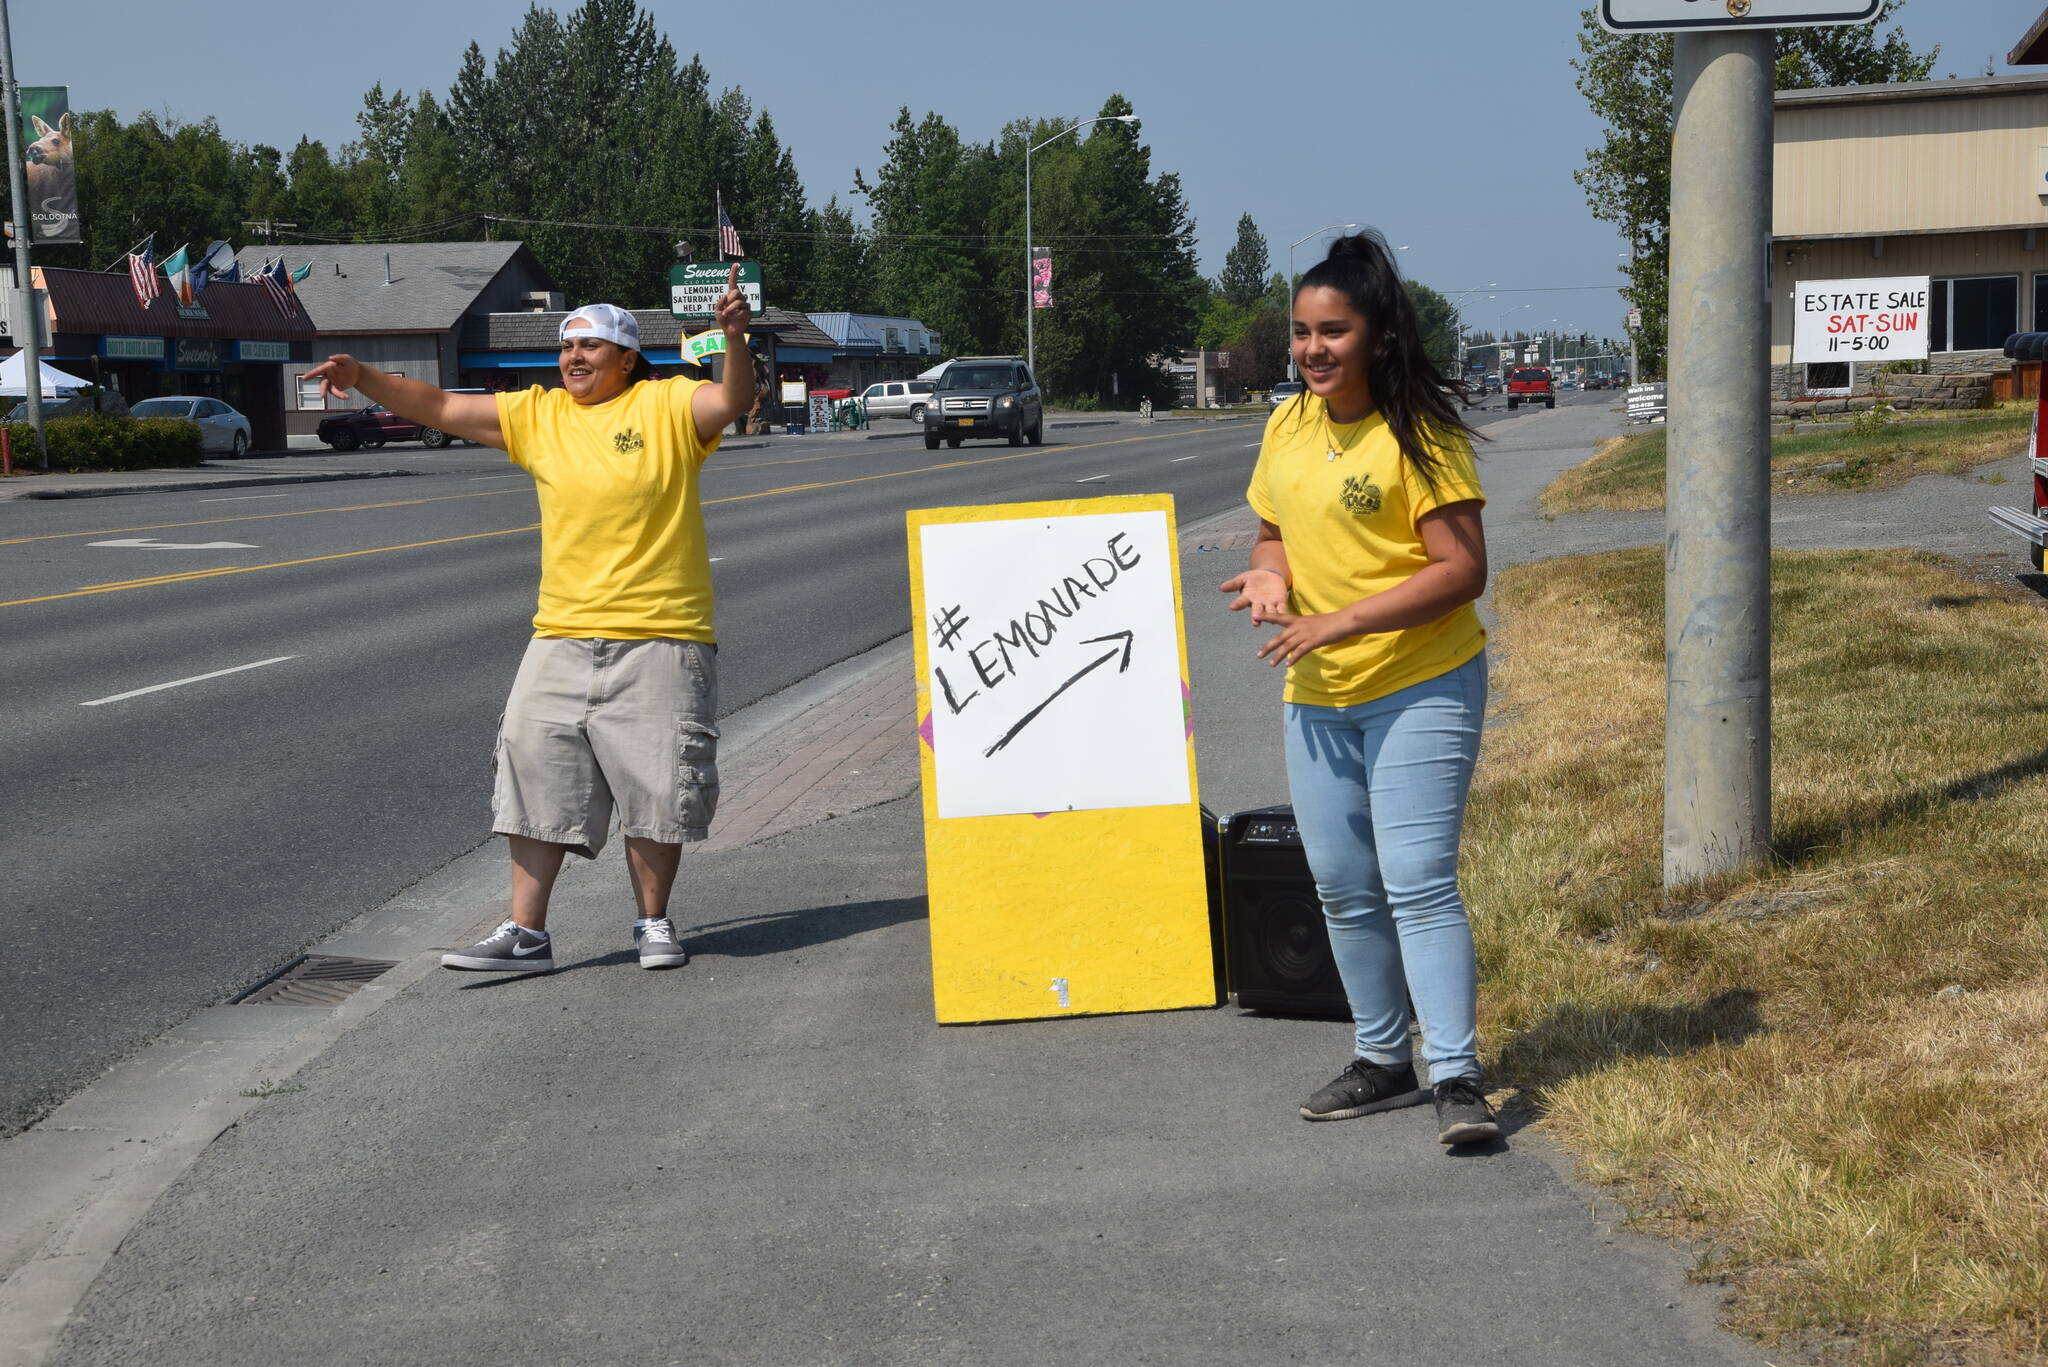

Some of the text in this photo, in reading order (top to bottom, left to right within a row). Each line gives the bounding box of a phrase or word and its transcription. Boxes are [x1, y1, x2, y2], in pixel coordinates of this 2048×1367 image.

[32, 212, 78, 222] SOLDOTNA
[684, 286, 724, 295] LEMONADE
[673, 295, 713, 304] SATURDAY
[1804, 291, 1926, 312] ESTATE SALE
[683, 304, 702, 312] HELP
[1827, 312, 1918, 333] SAT-SUN
[1628, 394, 1664, 403] welcome
[934, 531, 1141, 715] LEMONADE
